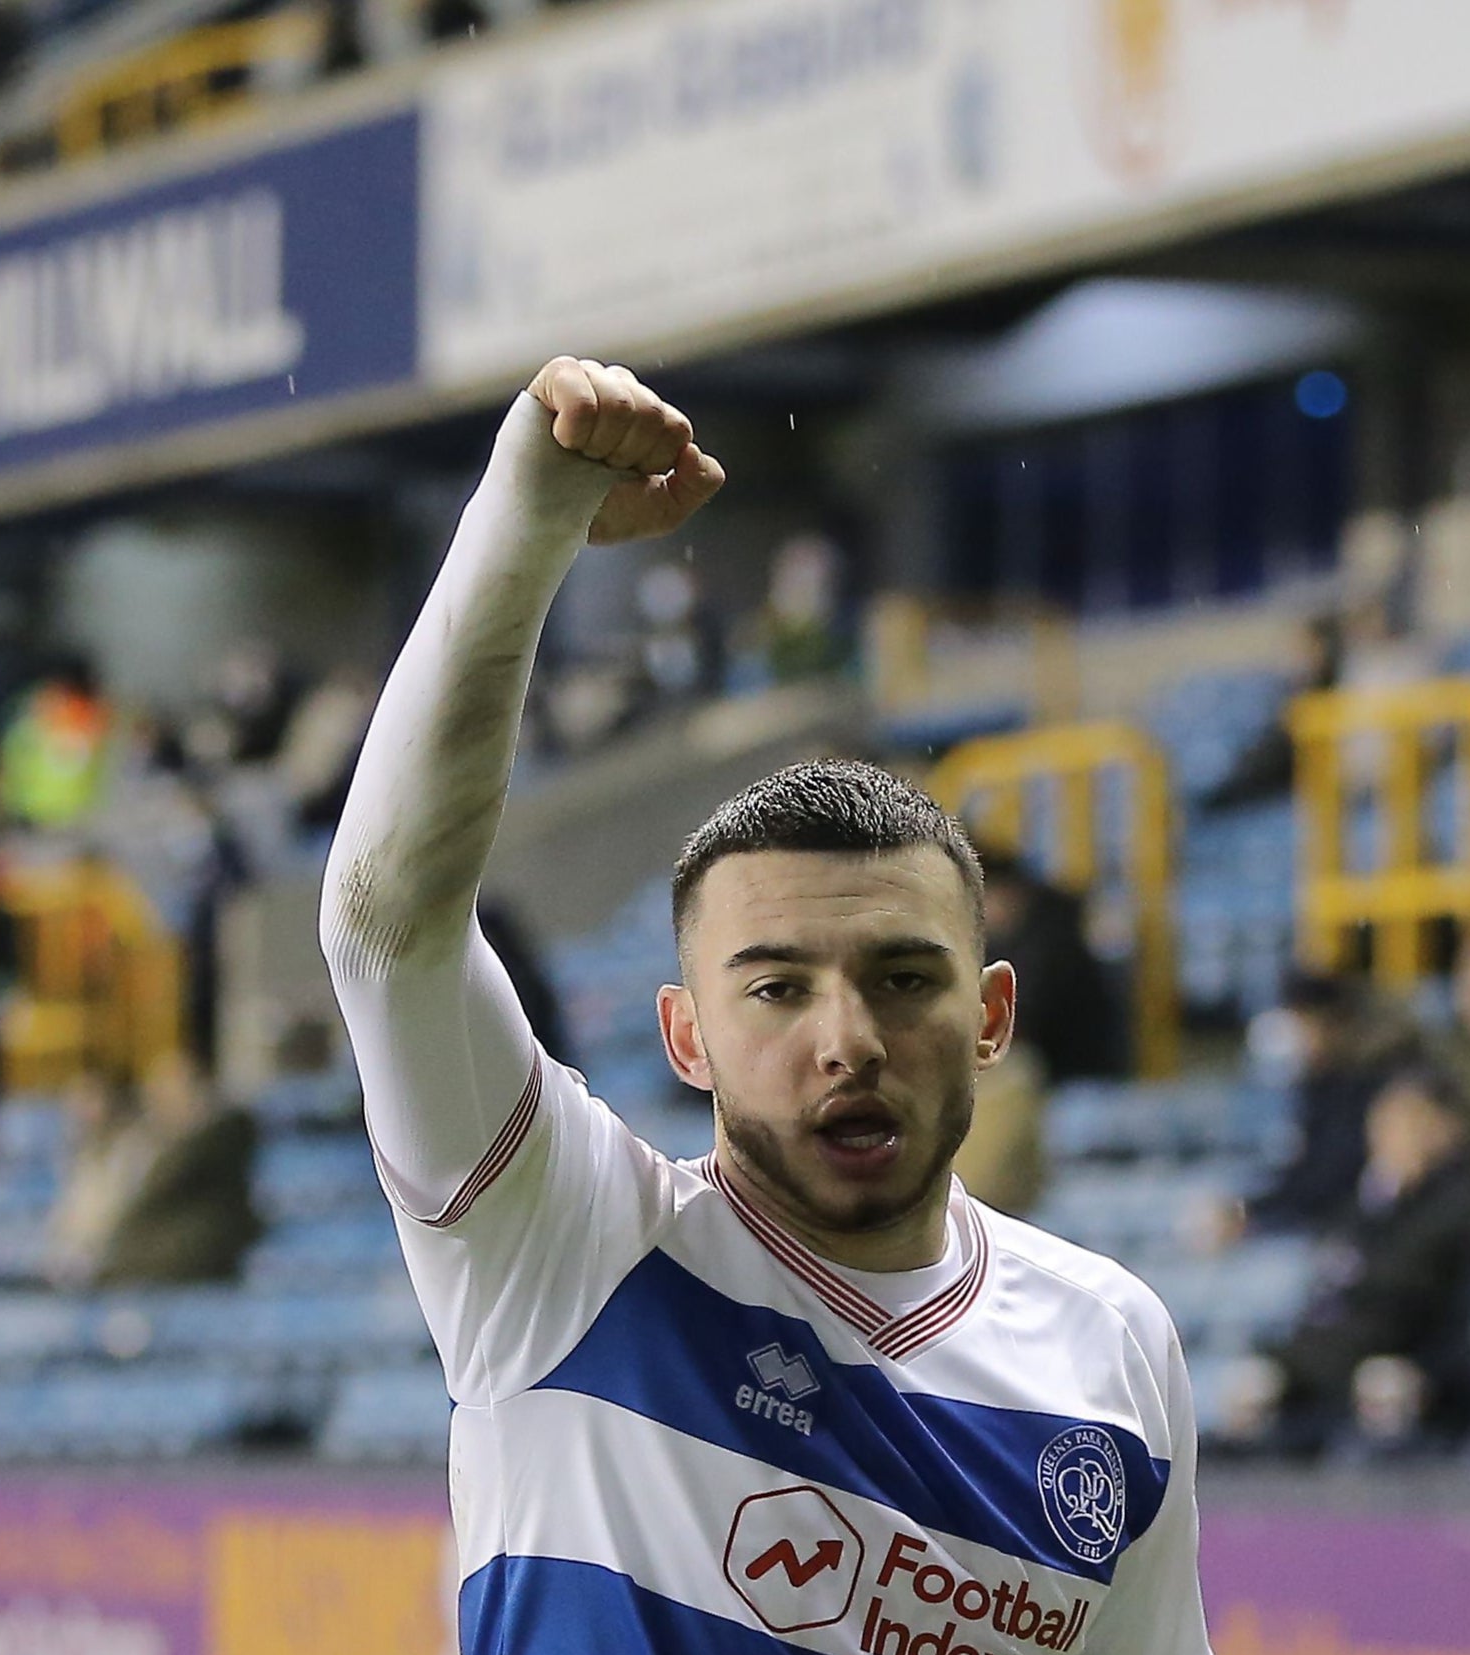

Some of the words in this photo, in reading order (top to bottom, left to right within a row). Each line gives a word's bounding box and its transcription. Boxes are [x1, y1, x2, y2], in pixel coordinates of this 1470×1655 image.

[735, 1384, 813, 1436] errea
[1042, 1436, 1072, 1490] QUEENS
[1075, 1431, 1102, 1447] PARK
[876, 1532, 1089, 1652] Football
